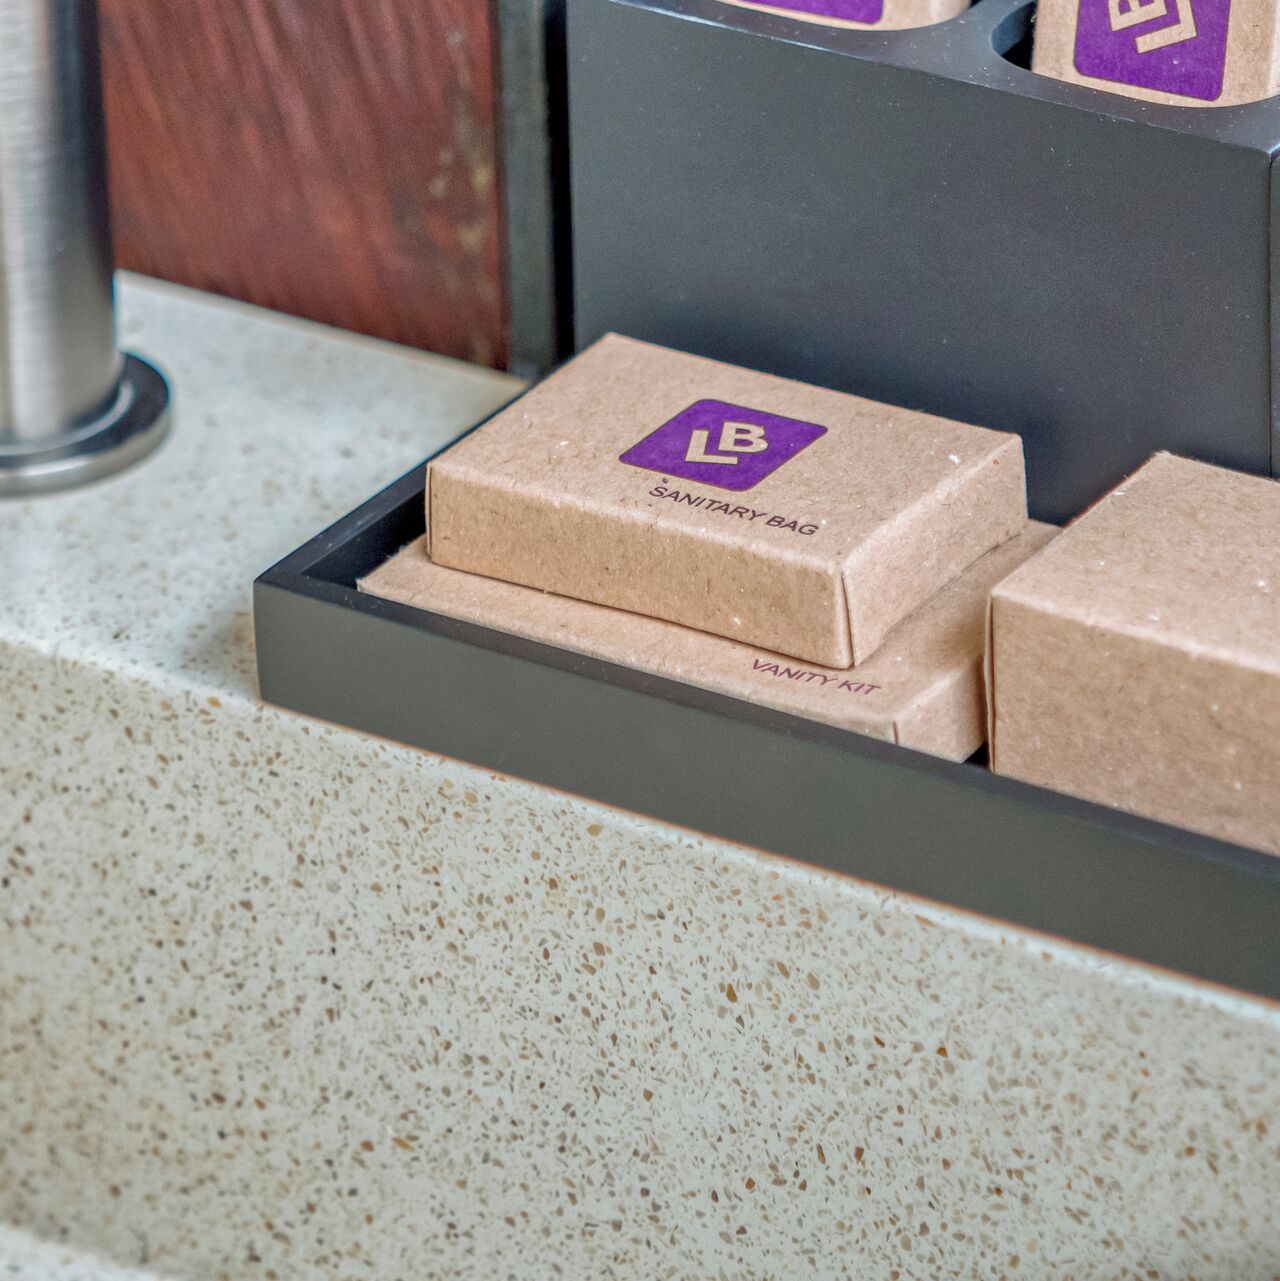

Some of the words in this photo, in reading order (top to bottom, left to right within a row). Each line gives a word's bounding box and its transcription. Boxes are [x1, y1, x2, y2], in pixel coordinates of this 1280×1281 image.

[649, 486, 767, 522] SANITARY
[766, 514, 820, 537] BAG
[751, 658, 839, 687] VANITY
[837, 679, 882, 697] KIT
